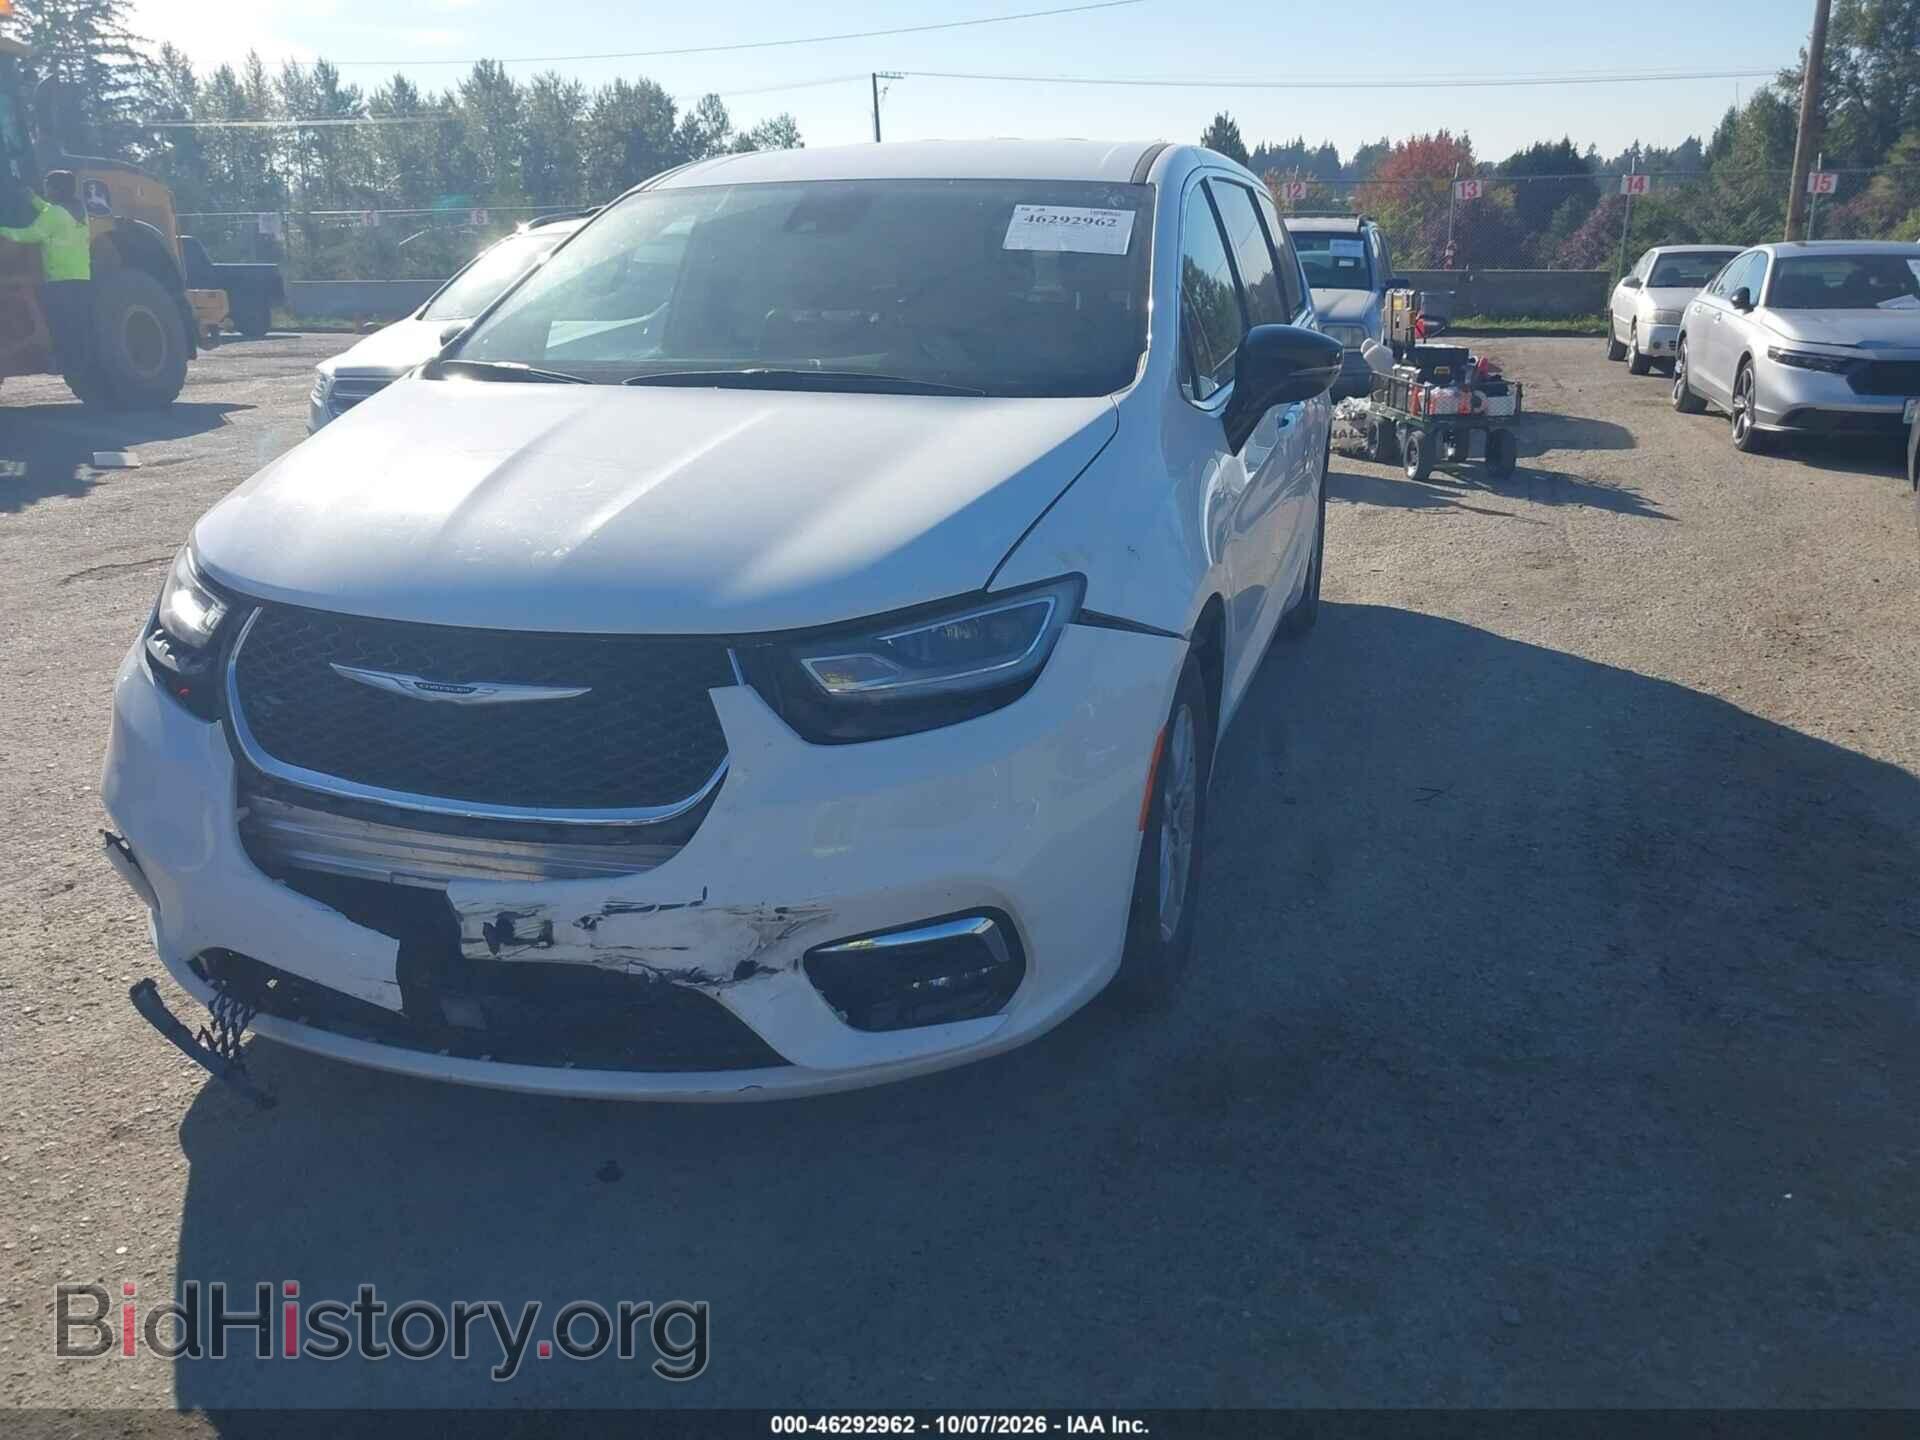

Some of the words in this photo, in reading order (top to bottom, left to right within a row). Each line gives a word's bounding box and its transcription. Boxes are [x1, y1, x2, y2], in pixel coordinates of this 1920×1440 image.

[1287, 183, 1303, 199] 12
[1461, 181, 1478, 198] 13
[1626, 175, 1644, 192] 14
[1813, 175, 1833, 192] 15
[1024, 214, 1117, 227] 46292962
